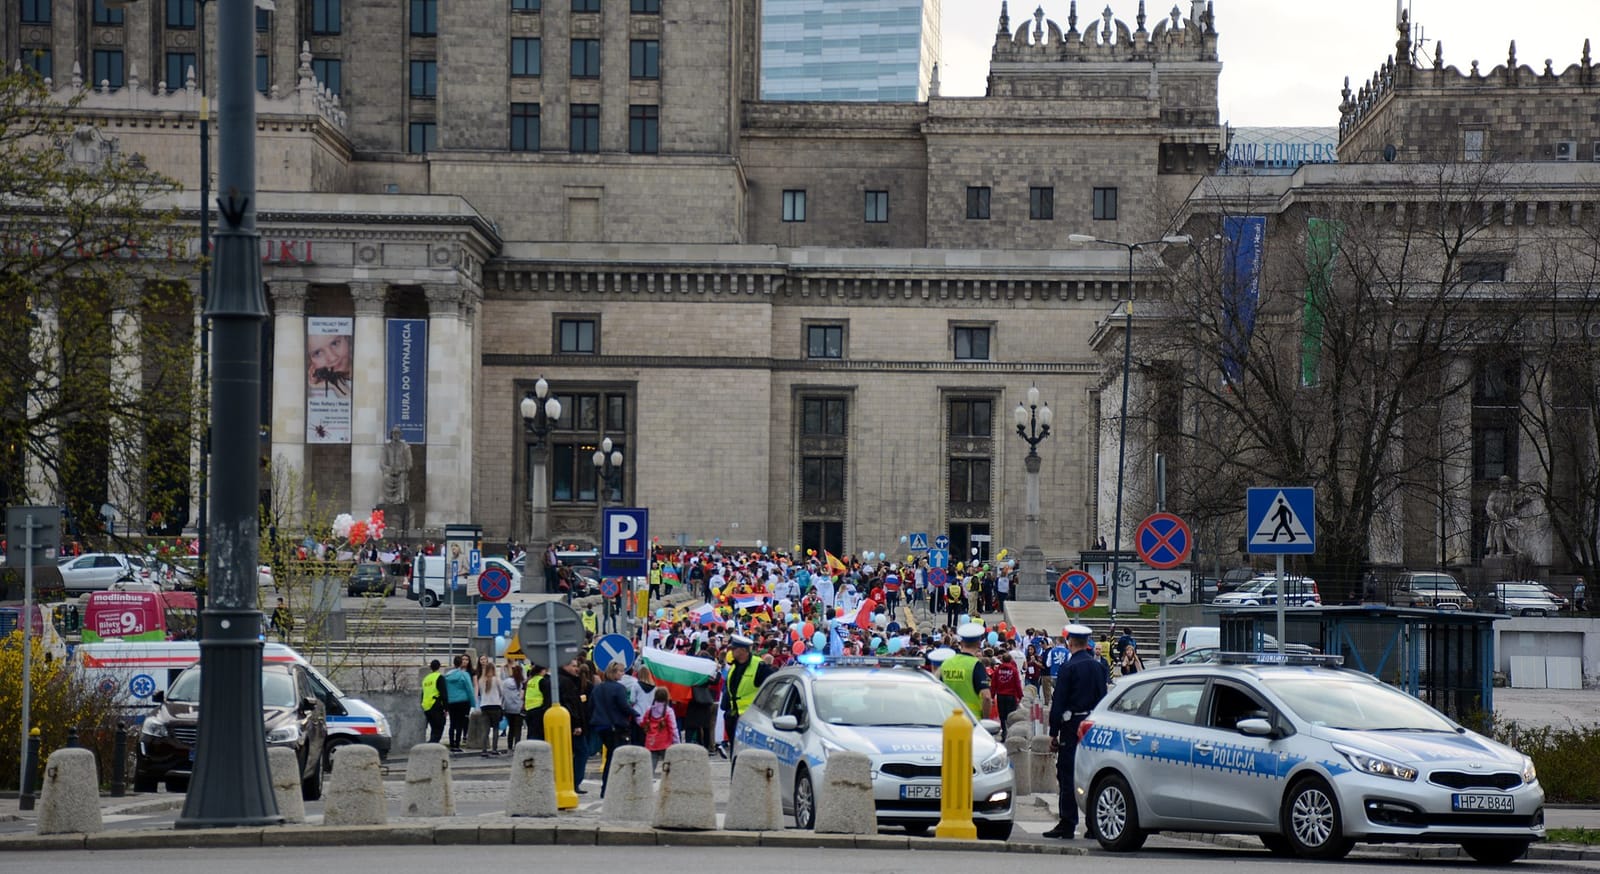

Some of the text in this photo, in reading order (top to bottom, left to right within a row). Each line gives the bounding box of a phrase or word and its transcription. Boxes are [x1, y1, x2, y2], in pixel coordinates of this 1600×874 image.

[1264, 143, 1335, 169] TOWERS
[402, 376, 410, 390] DO
[401, 392, 410, 420] BIURA
[609, 514, 638, 555] P
[471, 551, 479, 568] P
[121, 612, 136, 632] 9
[943, 669, 964, 680] POLICJA
[1090, 729, 1113, 746] Z 672
[891, 744, 943, 752] POLIC
[1212, 747, 1256, 770] POLICJA
[907, 787, 931, 798] HPZ
[1460, 795, 1512, 810] HPZ B844
